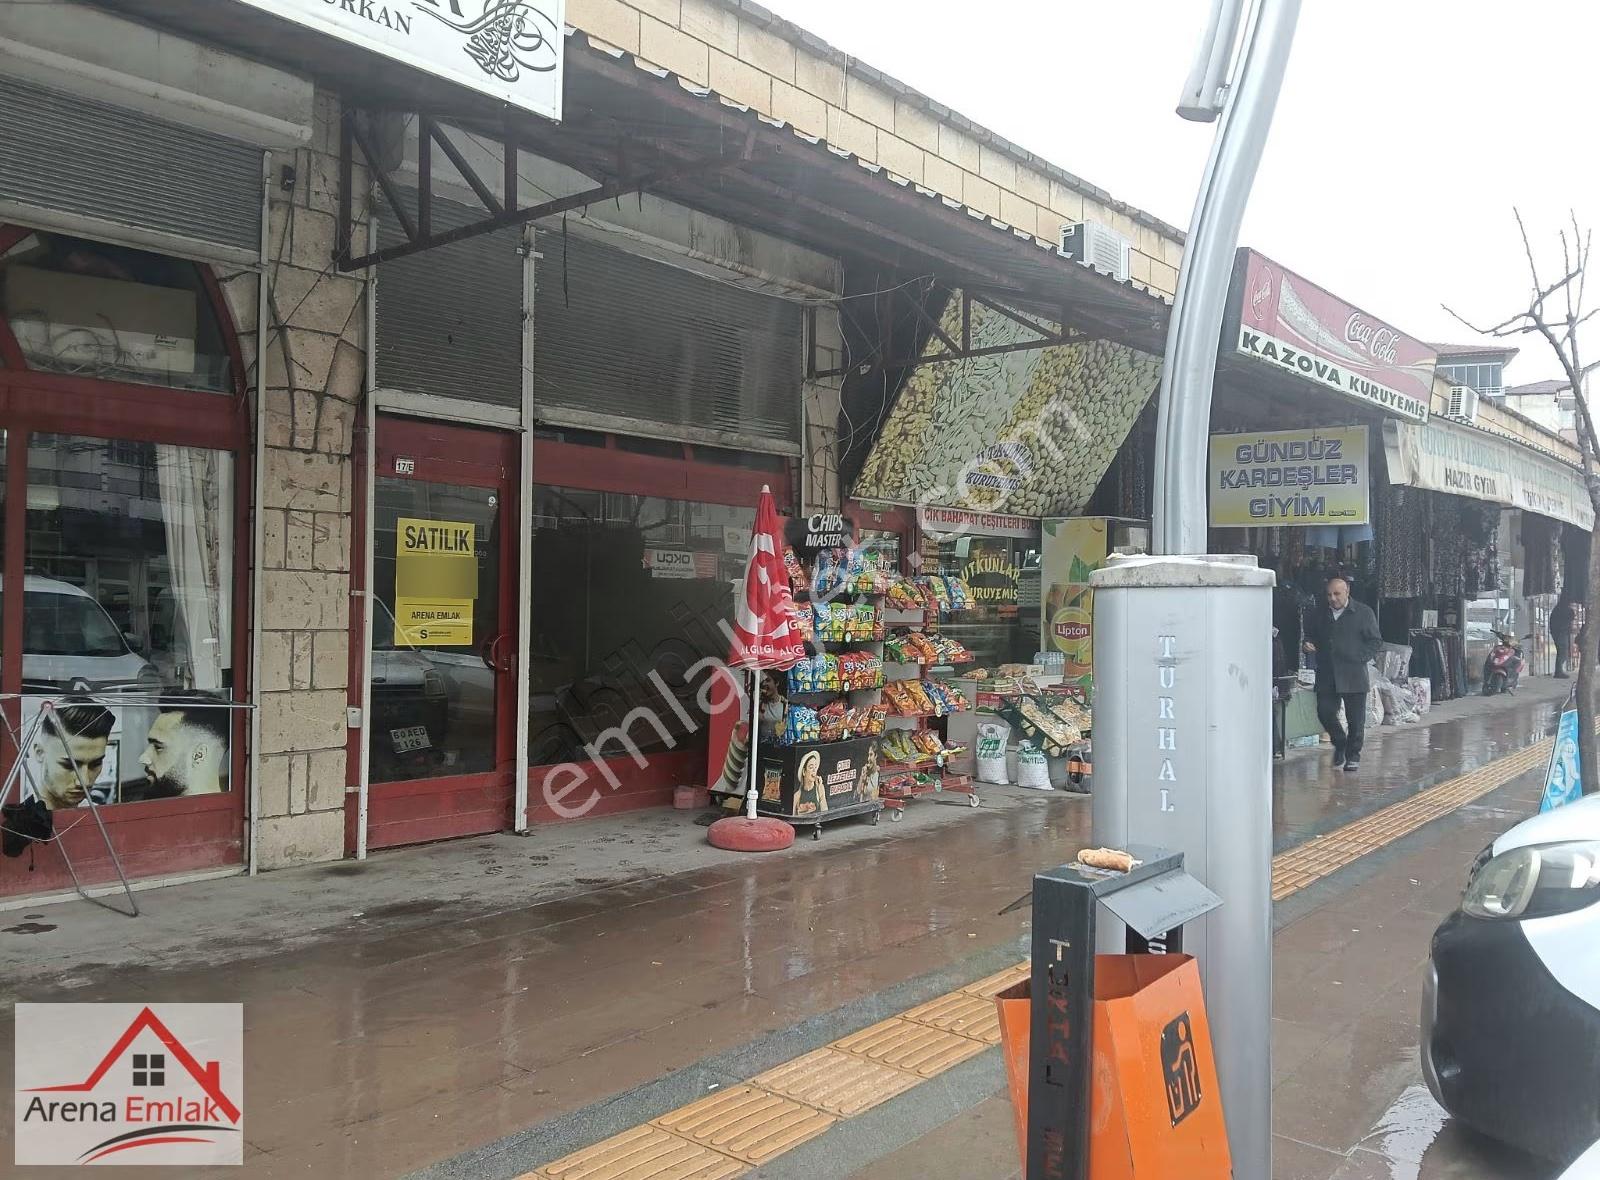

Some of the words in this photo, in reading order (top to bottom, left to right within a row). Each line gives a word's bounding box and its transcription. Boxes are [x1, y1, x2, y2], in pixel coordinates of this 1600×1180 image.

[1242, 331, 1341, 386] KAZOVA
[1235, 436, 1343, 464] GÜNDÜZ
[1220, 464, 1358, 490] KARDEŞLER
[1445, 467, 1473, 491] HAZIR
[941, 510, 980, 526] BAHARAT
[1250, 493, 1326, 518] GİYİM
[807, 513, 843, 532] CHIPS
[405, 525, 470, 551] SATILIK
[805, 533, 842, 547] MASTER
[961, 557, 1020, 584] UTKUNLAR
[411, 611, 435, 620] ARENA
[436, 611, 461, 620] EMLAK
[1057, 624, 1088, 637] Lipton
[1157, 634, 1177, 812] TURHAL
